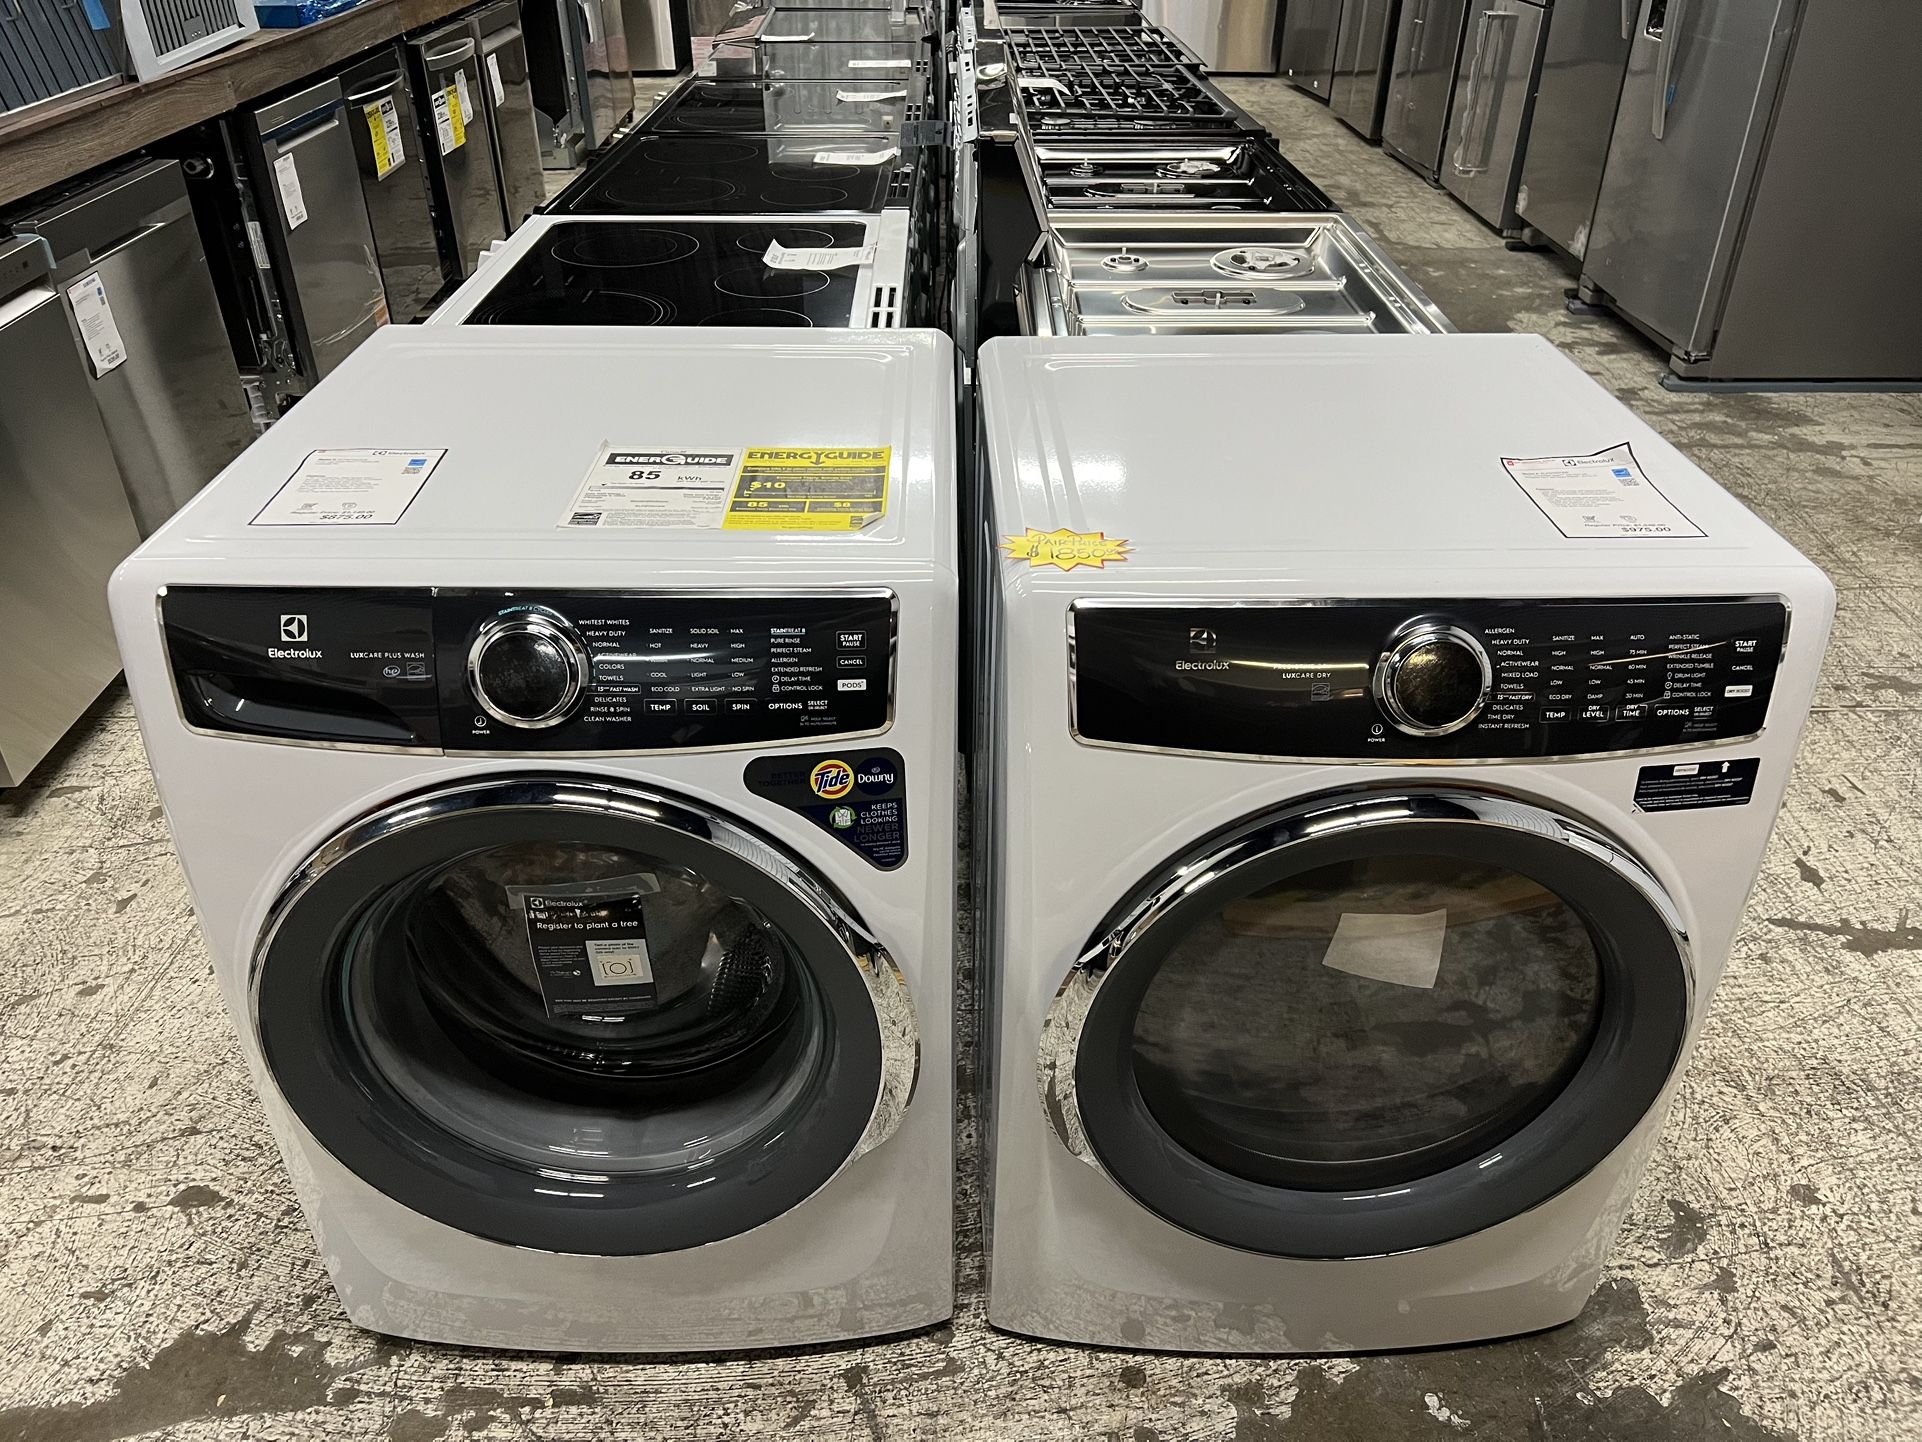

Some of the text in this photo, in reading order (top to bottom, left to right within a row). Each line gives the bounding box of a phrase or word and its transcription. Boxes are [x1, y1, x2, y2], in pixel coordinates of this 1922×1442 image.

[615, 454, 727, 465] ENERGUIDE
[748, 451, 884, 460] ENERGYGUIDE
[629, 471, 661, 480] 85
[268, 648, 322, 659] Electrolux
[1176, 660, 1230, 670] Electrolux
[815, 768, 850, 794] Tide
[858, 773, 893, 784] Downy
[860, 816, 897, 824] LOOKING
[858, 824, 899, 832] NEWER
[854, 832, 899, 842] LONGER
[537, 922, 571, 930] Register
[587, 922, 609, 930] plant
